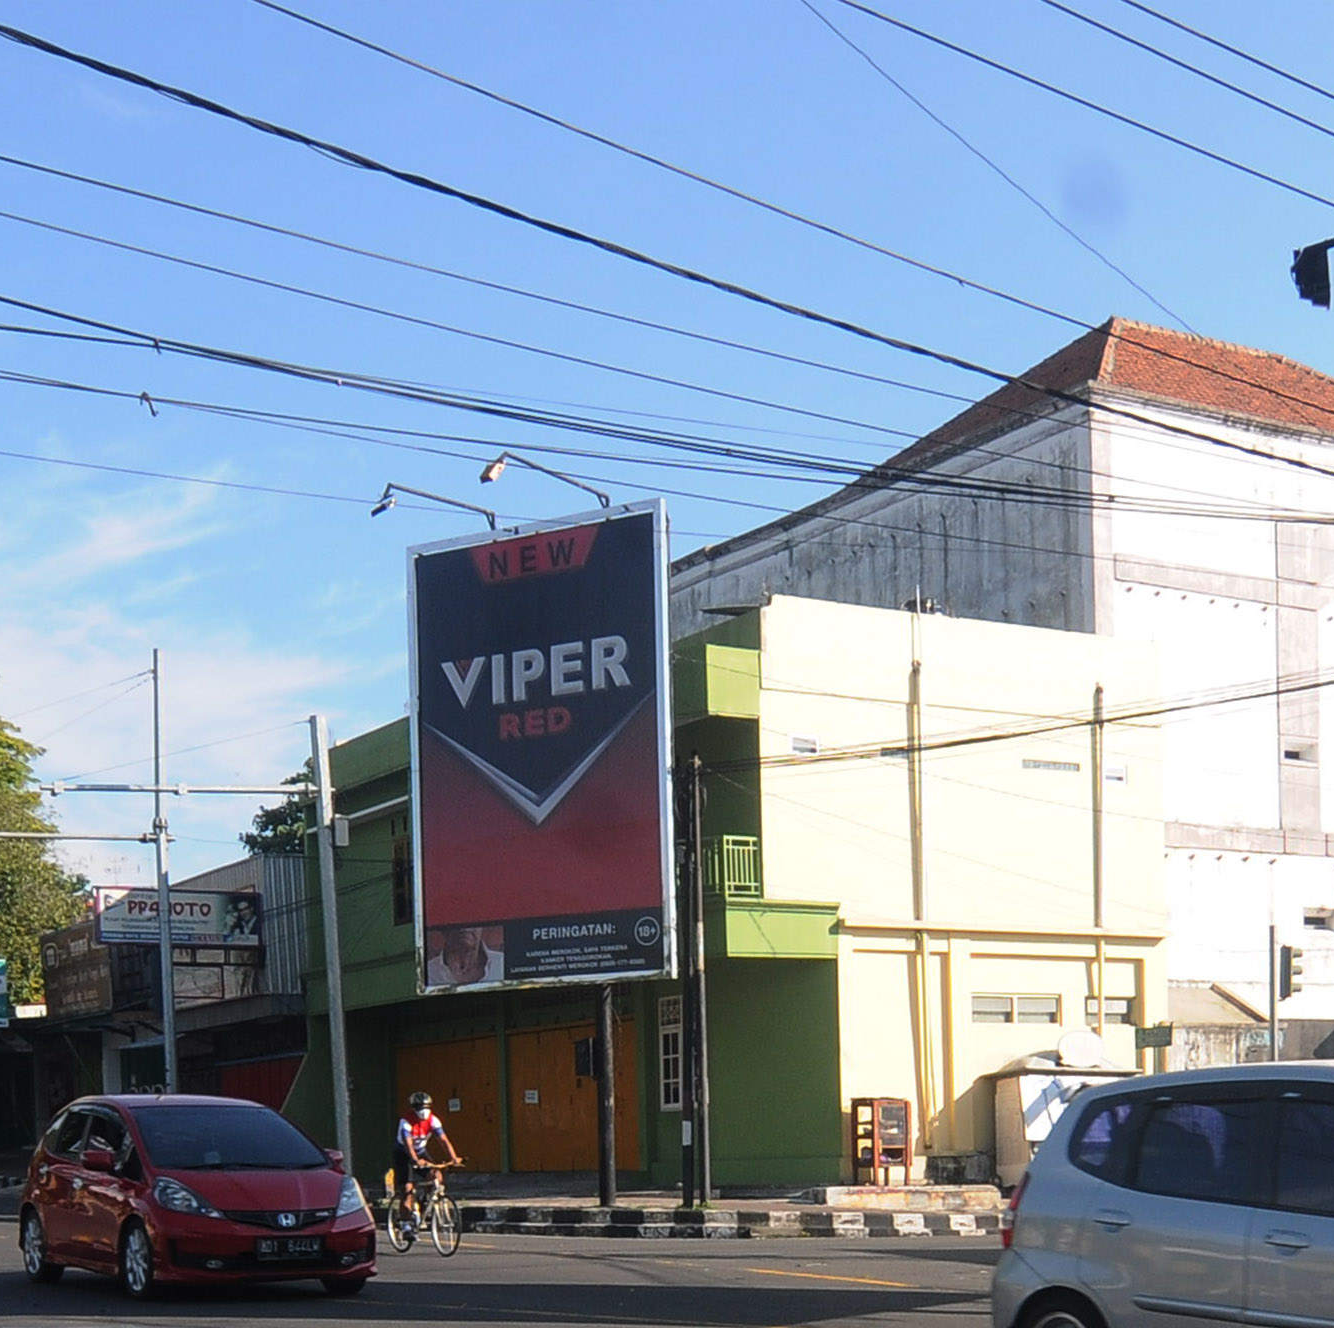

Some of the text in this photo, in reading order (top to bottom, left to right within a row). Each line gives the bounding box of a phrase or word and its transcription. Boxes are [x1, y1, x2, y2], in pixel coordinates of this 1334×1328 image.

[489, 537, 576, 581] NEW
[440, 635, 633, 710] VIPER
[498, 706, 573, 740] RED
[127, 900, 212, 917] PRAOTO
[532, 923, 617, 941] PERINGATAN:
[638, 925, 657, 937] 18+
